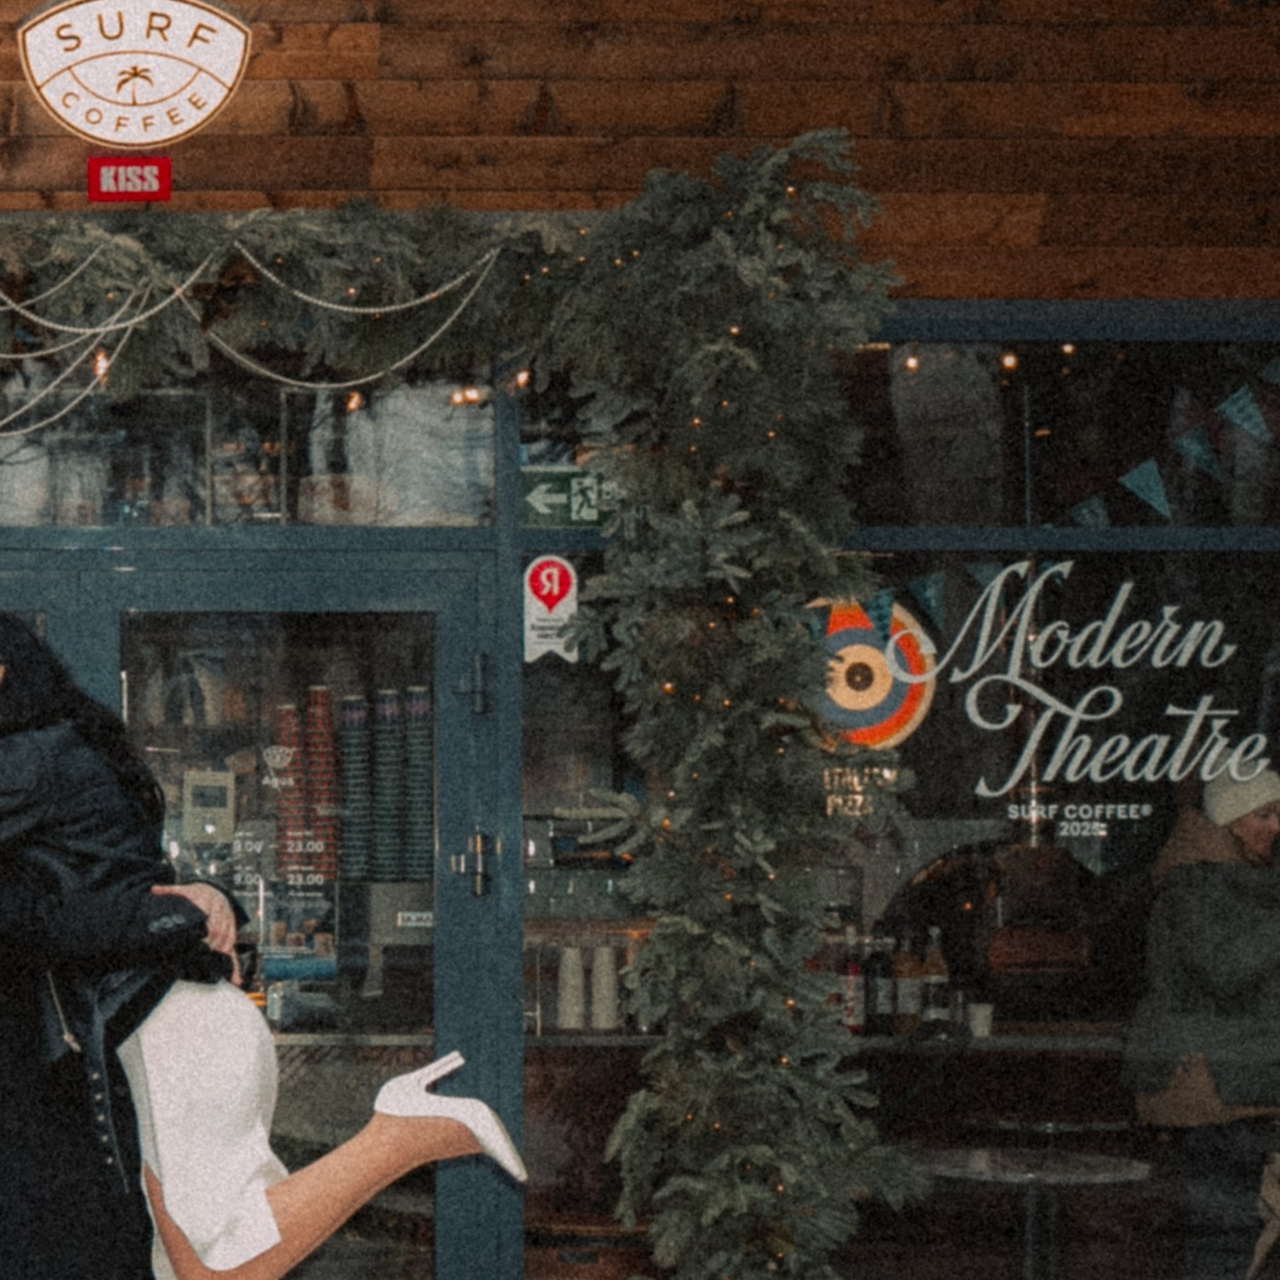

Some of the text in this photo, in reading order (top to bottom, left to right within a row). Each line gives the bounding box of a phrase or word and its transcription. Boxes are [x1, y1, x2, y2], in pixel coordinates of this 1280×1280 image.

[55, 11, 218, 52] SURF
[61, 92, 207, 133] COFFEE
[99, 165, 160, 193] KISS
[540, 567, 561, 596] Я
[885, 560, 1237, 683] Modern
[965, 674, 1271, 797] Theatre
[1008, 804, 1059, 820] SURF
[1059, 821, 1104, 837] 2025
[287, 840, 325, 852] 23.00
[287, 873, 325, 885] 23.00
